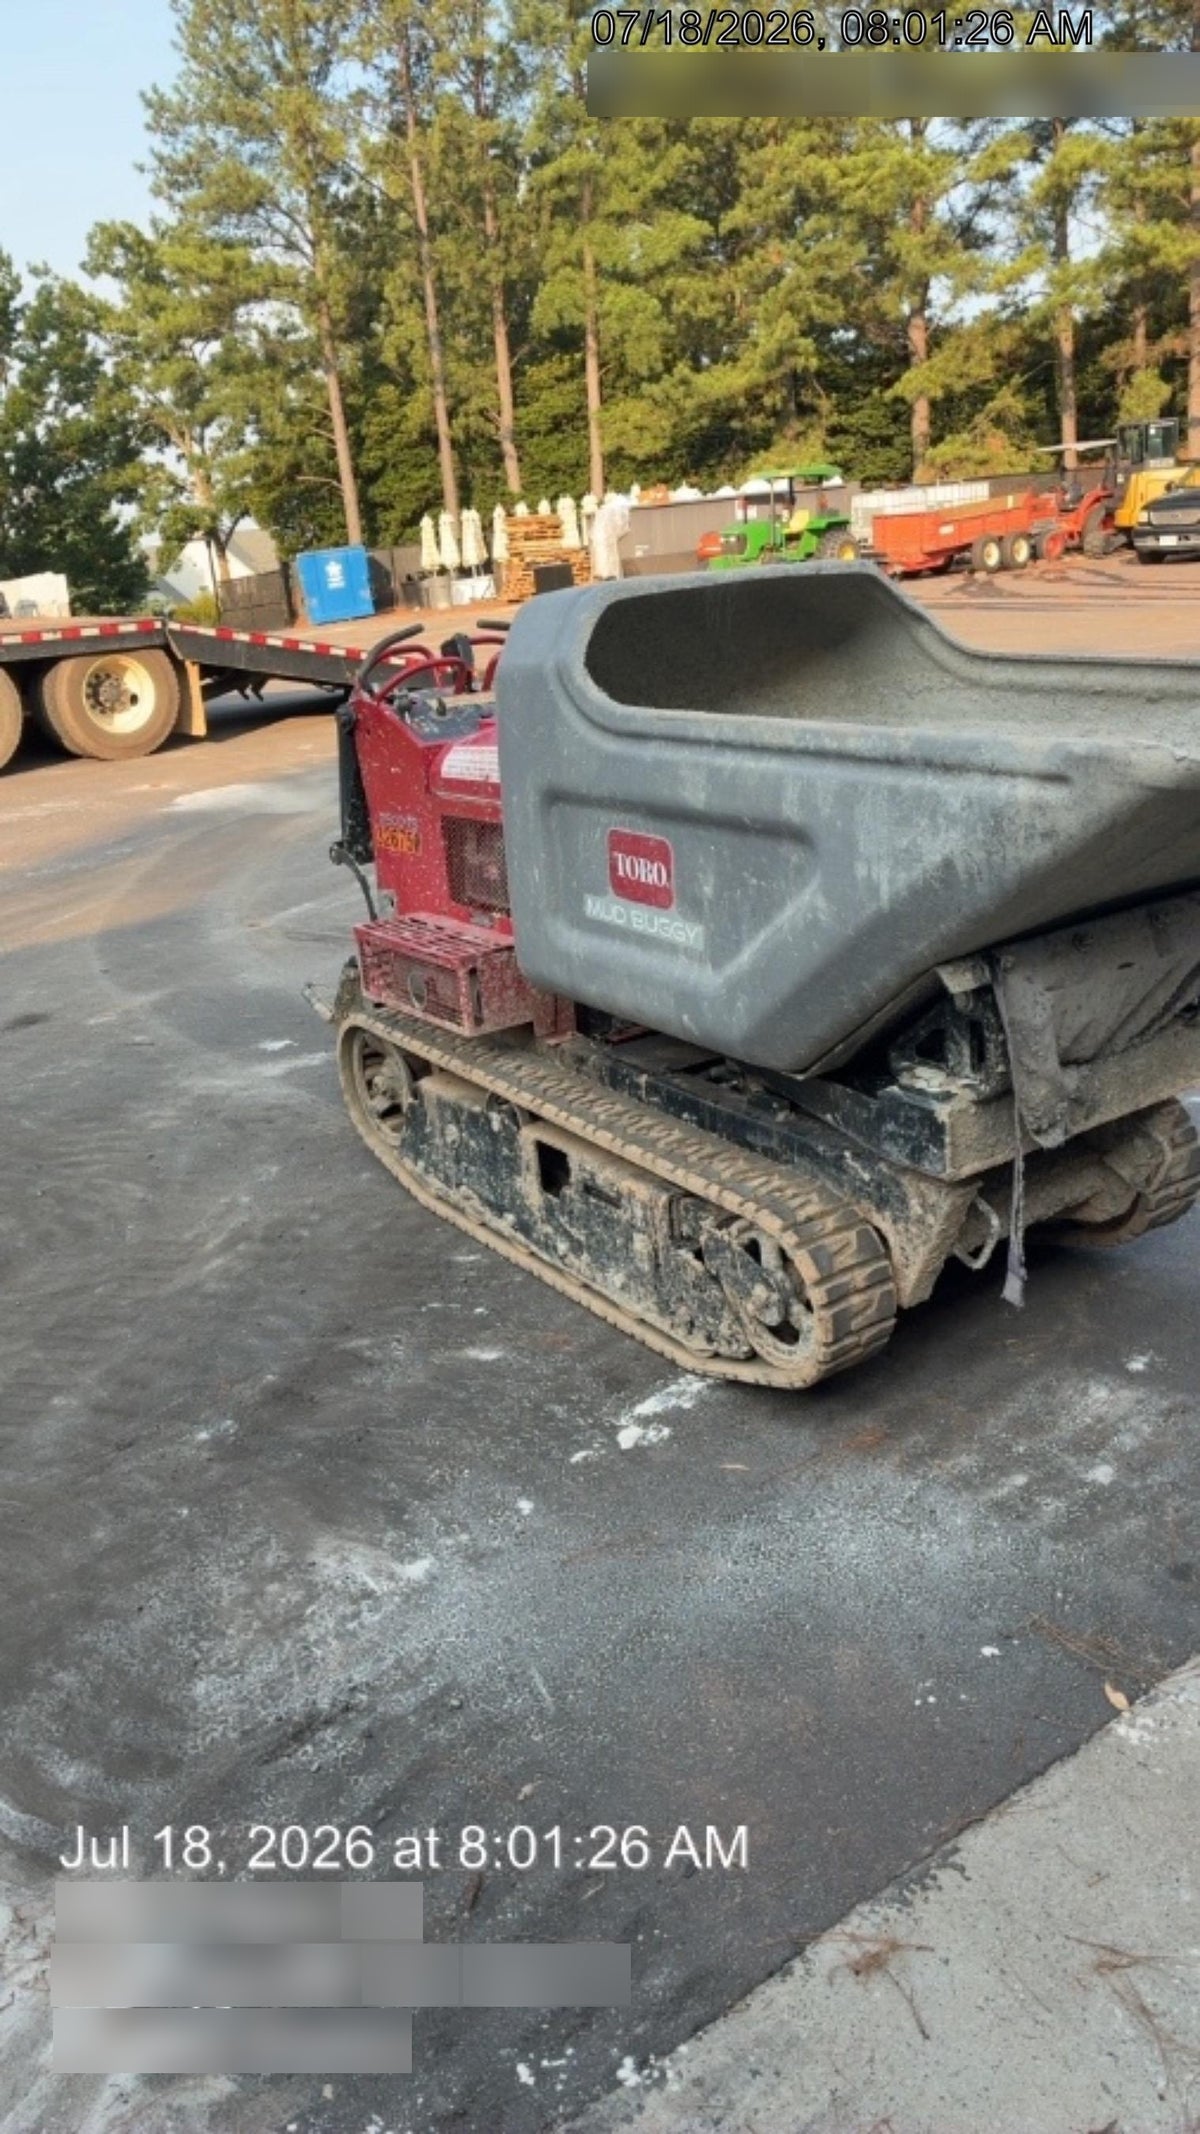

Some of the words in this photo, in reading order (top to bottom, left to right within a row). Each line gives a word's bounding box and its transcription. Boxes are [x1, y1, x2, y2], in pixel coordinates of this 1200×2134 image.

[614, 851, 667, 887] TORO
[585, 896, 626, 924] MUD
[630, 909, 698, 946] BUGGY
